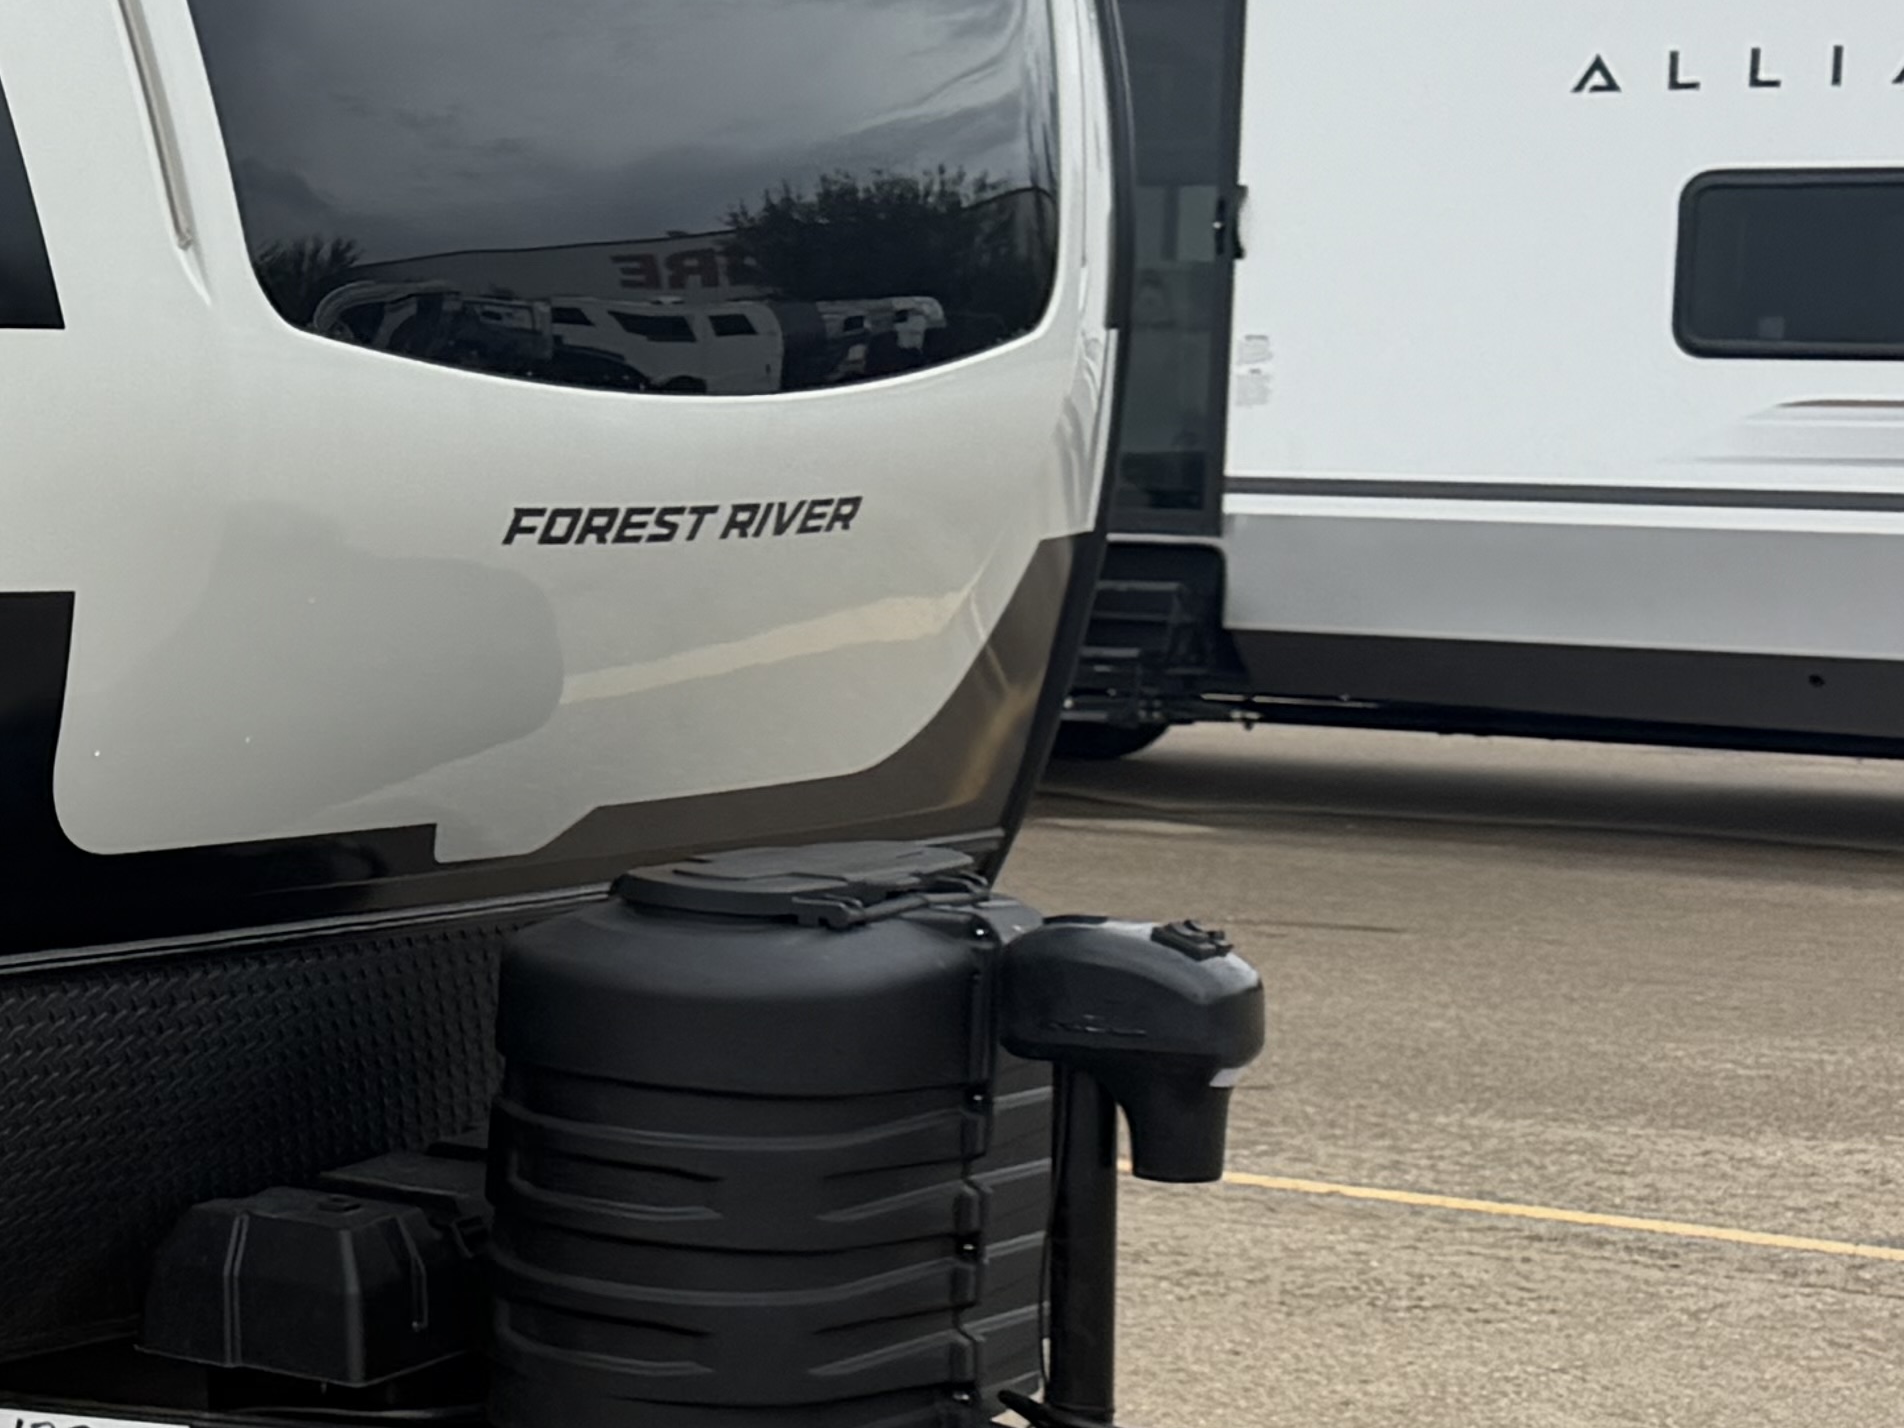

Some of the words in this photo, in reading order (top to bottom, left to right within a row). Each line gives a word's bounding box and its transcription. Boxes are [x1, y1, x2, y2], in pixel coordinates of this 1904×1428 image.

[1570, 44, 1904, 94] ALLI
[501, 504, 720, 546] FOREST
[718, 495, 864, 540] RIVER
